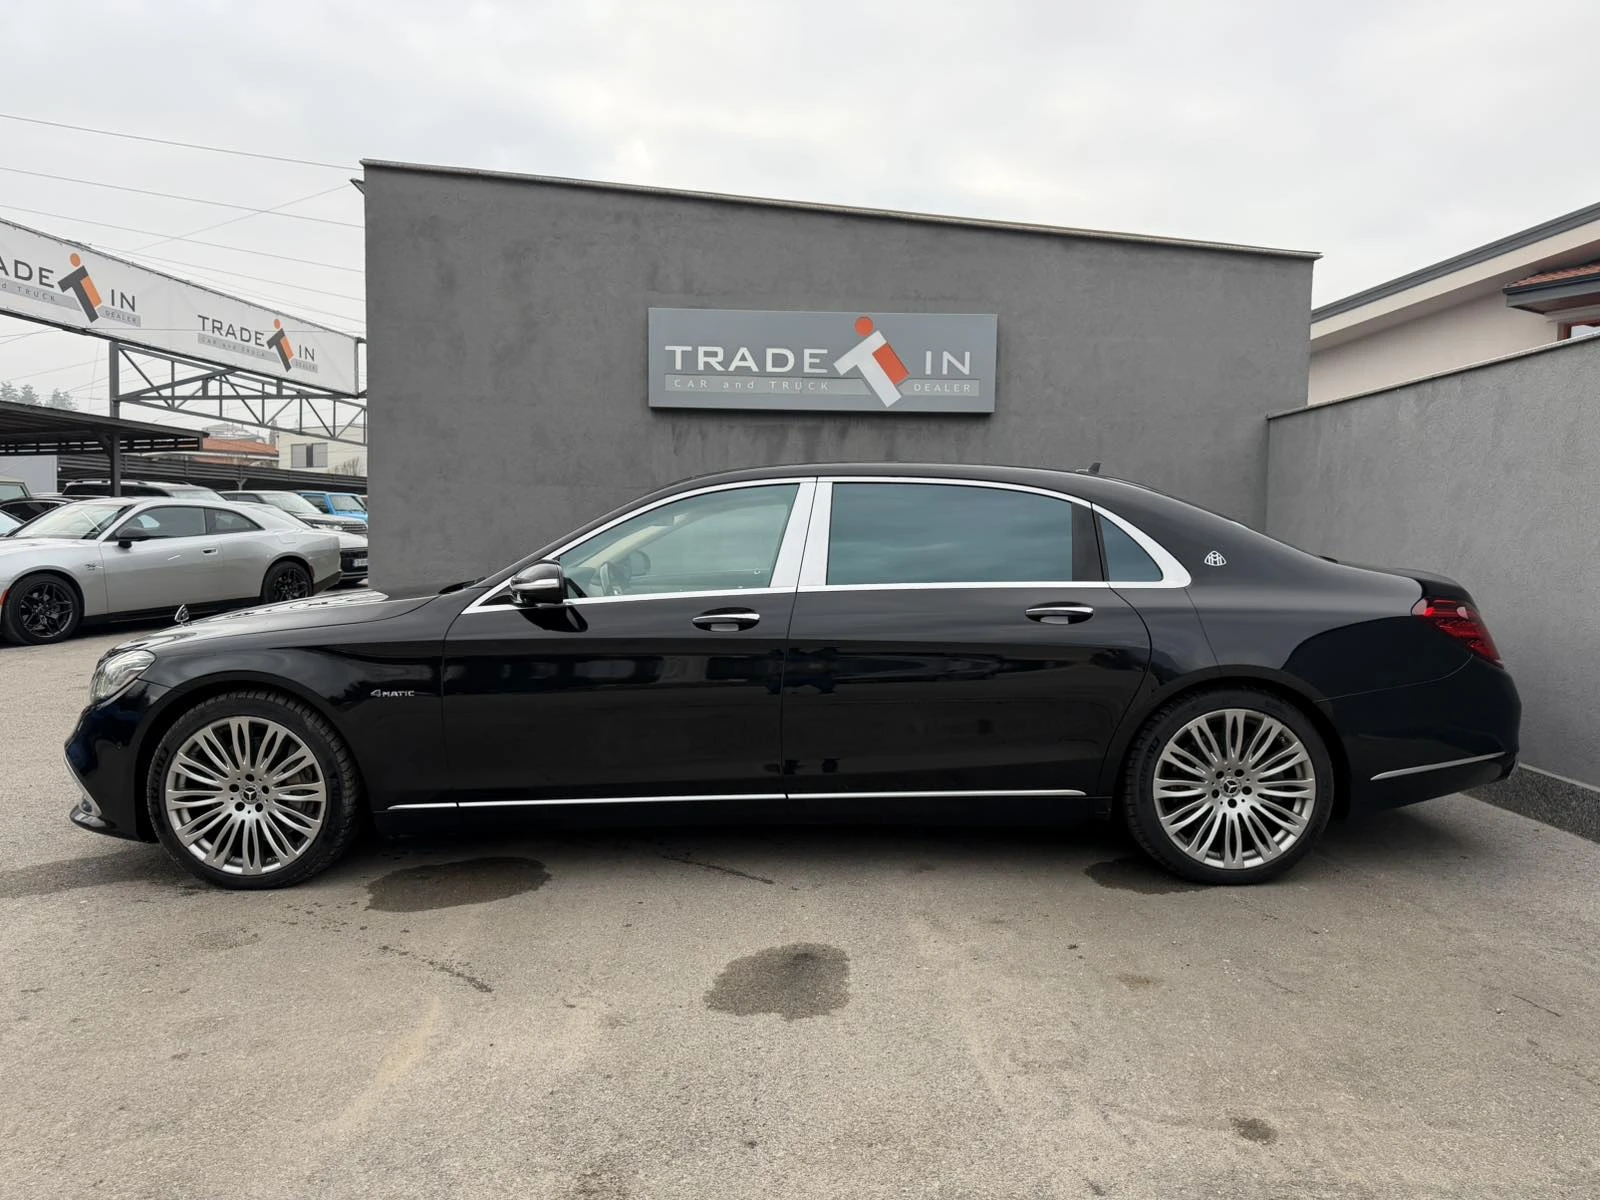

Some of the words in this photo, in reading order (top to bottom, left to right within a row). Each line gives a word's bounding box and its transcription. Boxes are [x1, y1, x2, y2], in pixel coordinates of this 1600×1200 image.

[17, 286, 55, 302] TRUCK
[110, 289, 136, 312] IN
[197, 314, 265, 347] TRADE
[298, 344, 315, 362] IN
[665, 345, 829, 373] TRADE
[925, 350, 971, 376] IN
[674, 379, 708, 389] CAR
[723, 380, 754, 390] and
[769, 381, 830, 391] TRUCK
[914, 383, 971, 393] DEALER
[370, 688, 415, 698] 4MATIC
